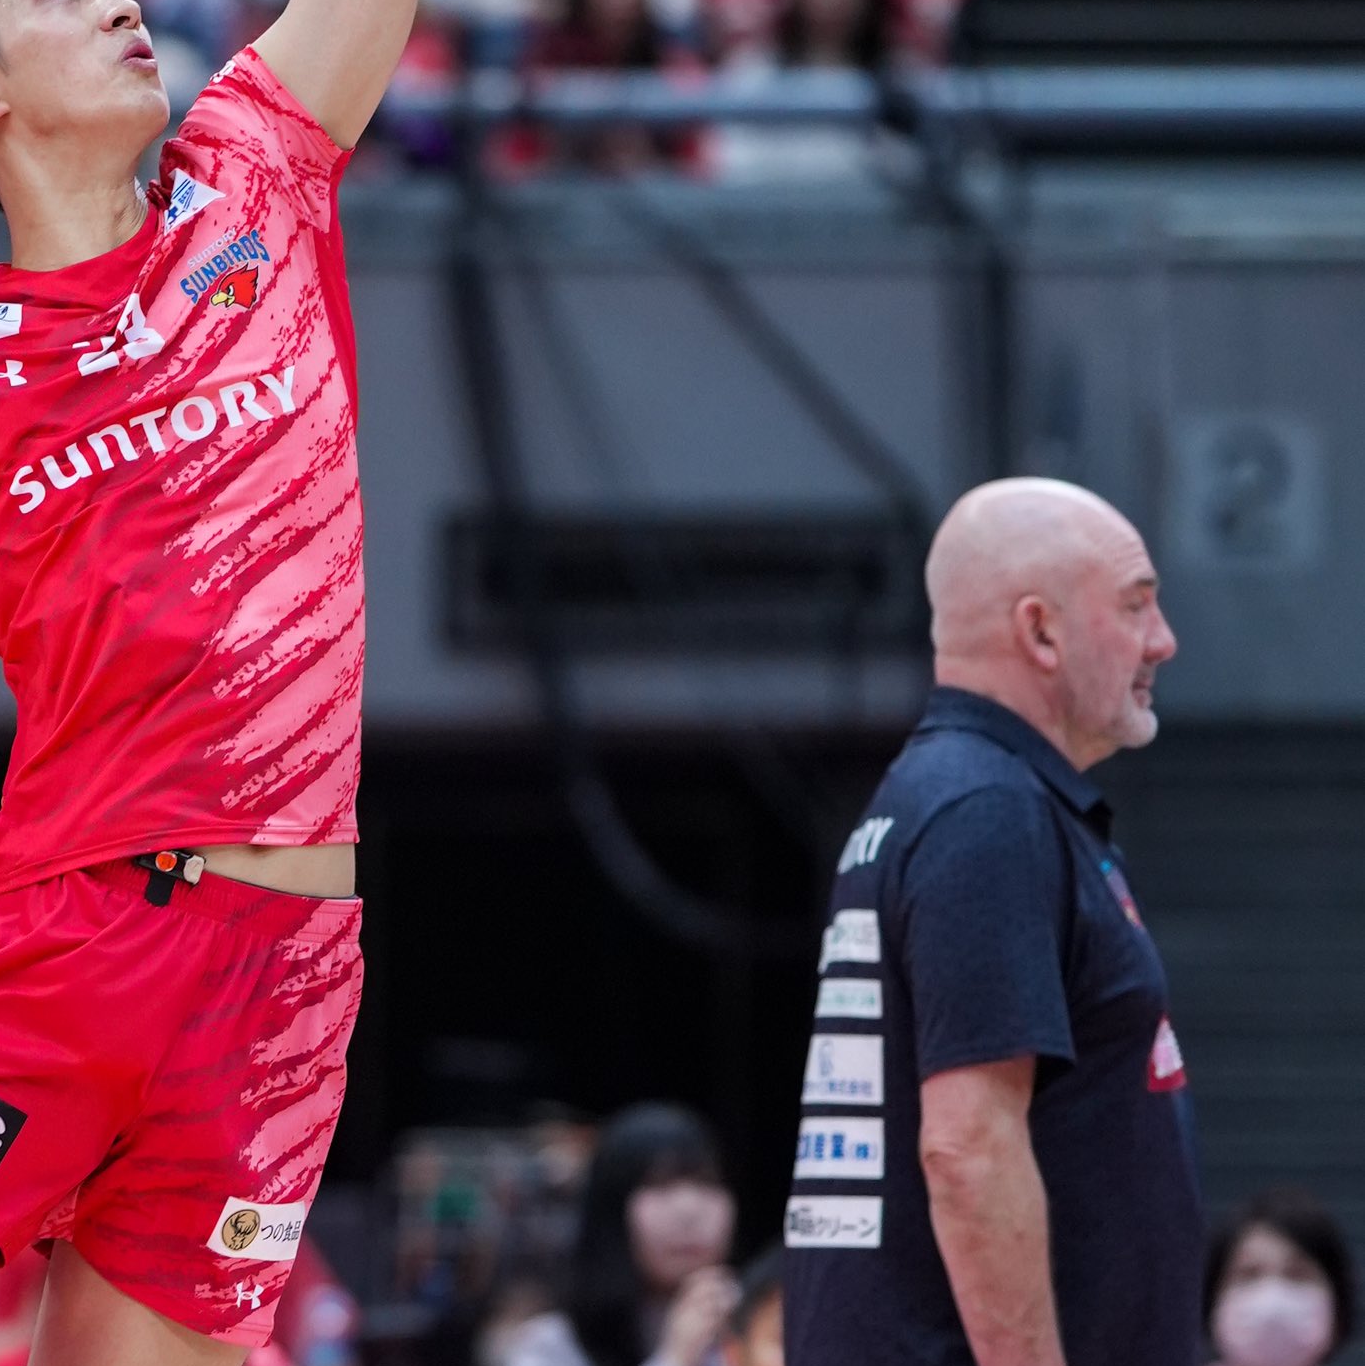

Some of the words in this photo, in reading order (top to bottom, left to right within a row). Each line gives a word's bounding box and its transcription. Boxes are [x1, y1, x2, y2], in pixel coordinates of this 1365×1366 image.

[179, 229, 271, 305] SUNBIRDS
[187, 226, 237, 268] SUNTORY
[9, 365, 297, 514] SUNTORY
[261, 1221, 302, 1242] つの食品
